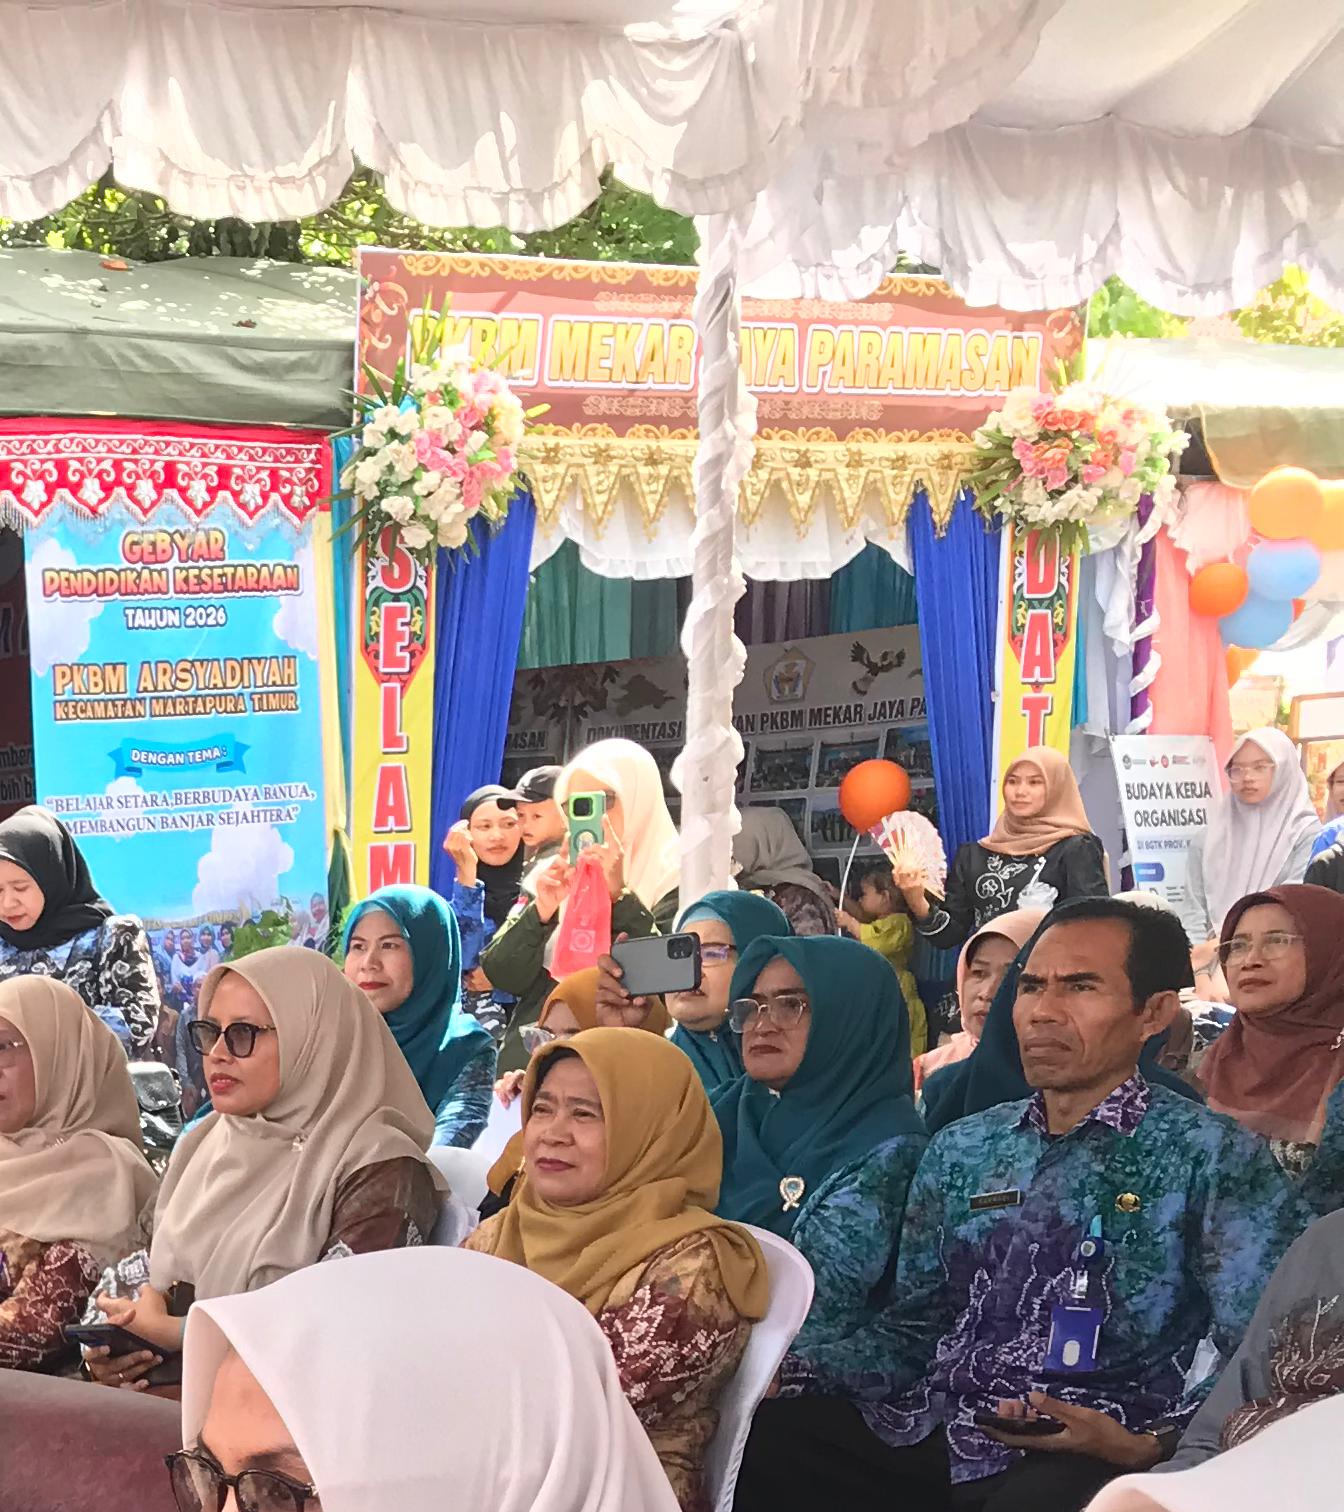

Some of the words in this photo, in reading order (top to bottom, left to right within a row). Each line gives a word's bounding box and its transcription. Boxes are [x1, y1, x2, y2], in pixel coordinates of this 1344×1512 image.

[549, 319, 695, 384] MEKAR
[807, 328, 1039, 391] PARAMASAN
[122, 530, 226, 564] GEBYAR
[42, 568, 168, 598] PENDIDIKAN
[174, 564, 299, 595] KESETARAAN
[125, 607, 180, 630] TAHUN
[184, 605, 227, 628] 2026
[53, 662, 127, 696] PKBM
[137, 656, 297, 693] ARSYADIYAH
[54, 697, 145, 721] KECAMATAN
[151, 694, 246, 717] MARTAPURA
[251, 692, 298, 712] TIMUR
[760, 709, 803, 731] PKBM
[808, 704, 863, 727] MEKAR
[868, 699, 905, 721] JAYA
[131, 748, 185, 766] DENGAN
[1126, 782, 1173, 800] BUDAYA
[1176, 781, 1212, 799] KERJA
[65, 816, 157, 835] MEMBANGUN
[160, 812, 215, 830] BANJAR
[1134, 808, 1207, 827] ORGANISASI
